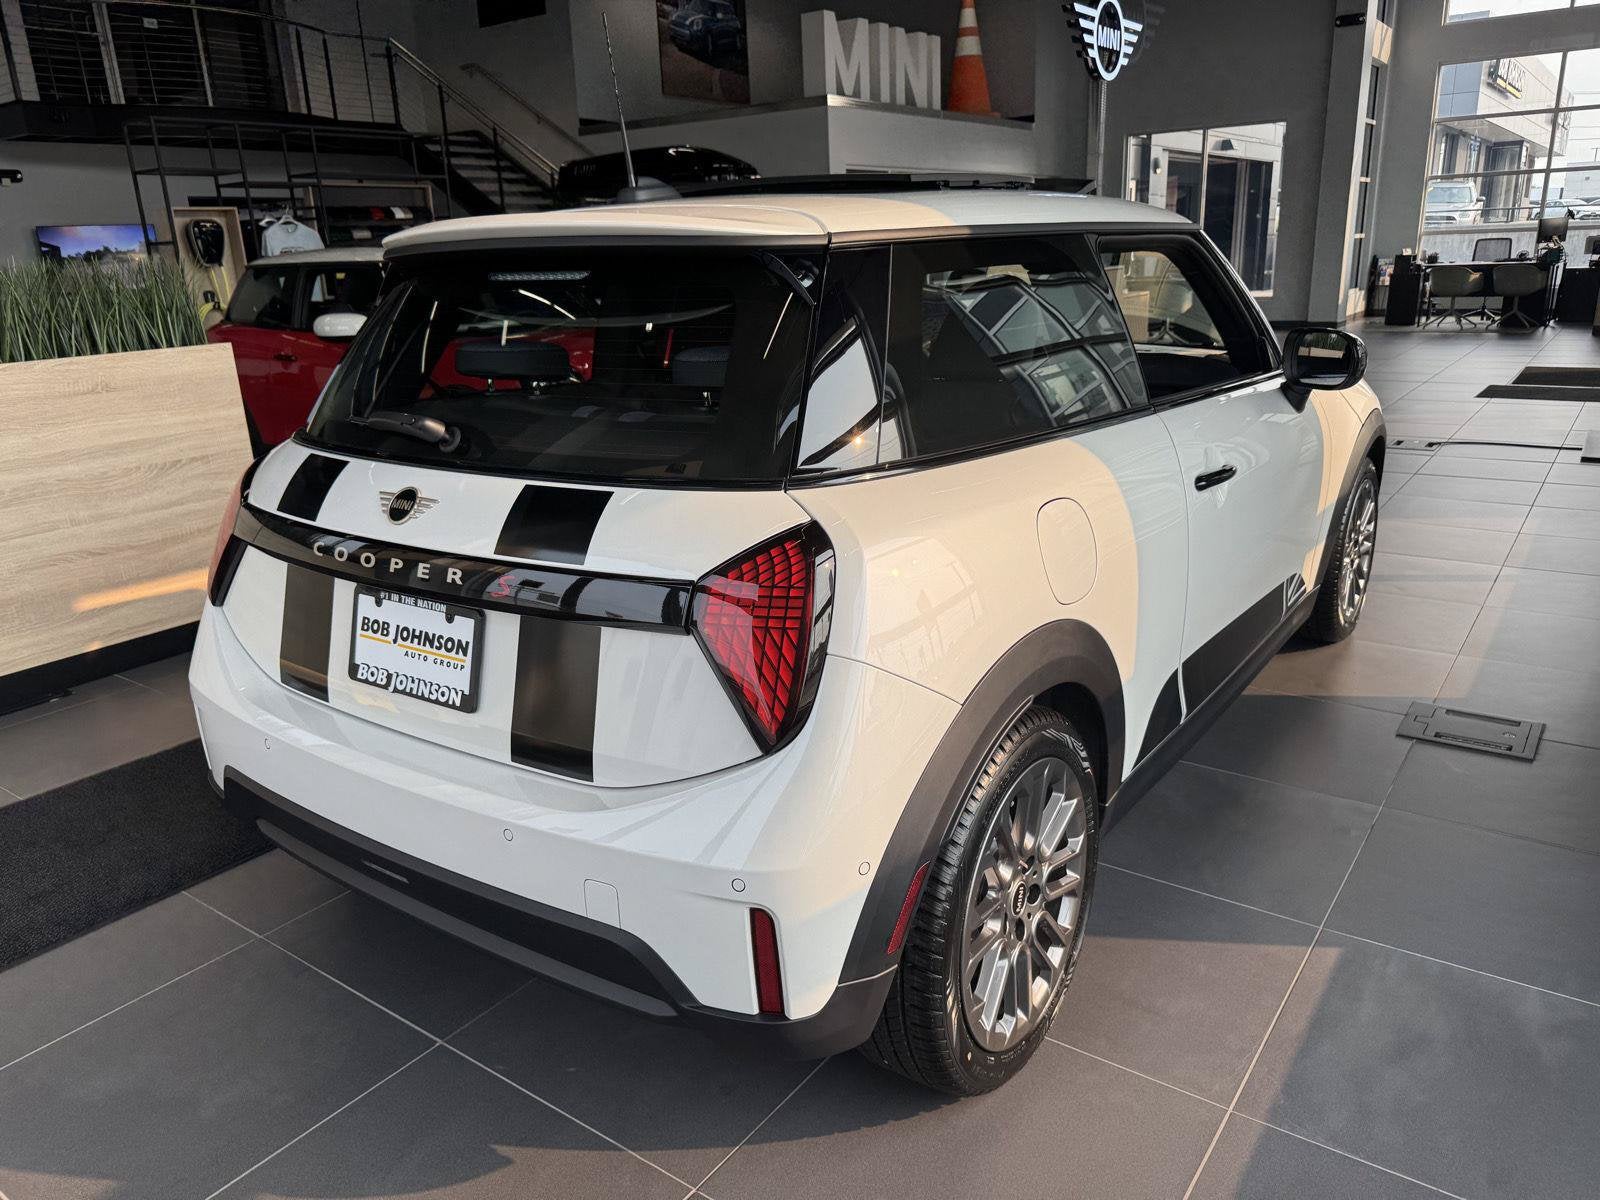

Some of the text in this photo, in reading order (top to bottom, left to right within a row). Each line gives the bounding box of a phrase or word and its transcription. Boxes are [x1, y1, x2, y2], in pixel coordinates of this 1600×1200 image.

[1098, 25, 1120, 51] MINI
[801, 9, 941, 111] MINI
[391, 499, 414, 510] MINI
[313, 541, 515, 598] COOPER S
[380, 591, 447, 612] #1 IN THE NATION
[361, 616, 470, 658] BOB JOHNSON
[404, 650, 465, 672] AUTO GROUP
[357, 663, 462, 707] BOB JOHNSON
